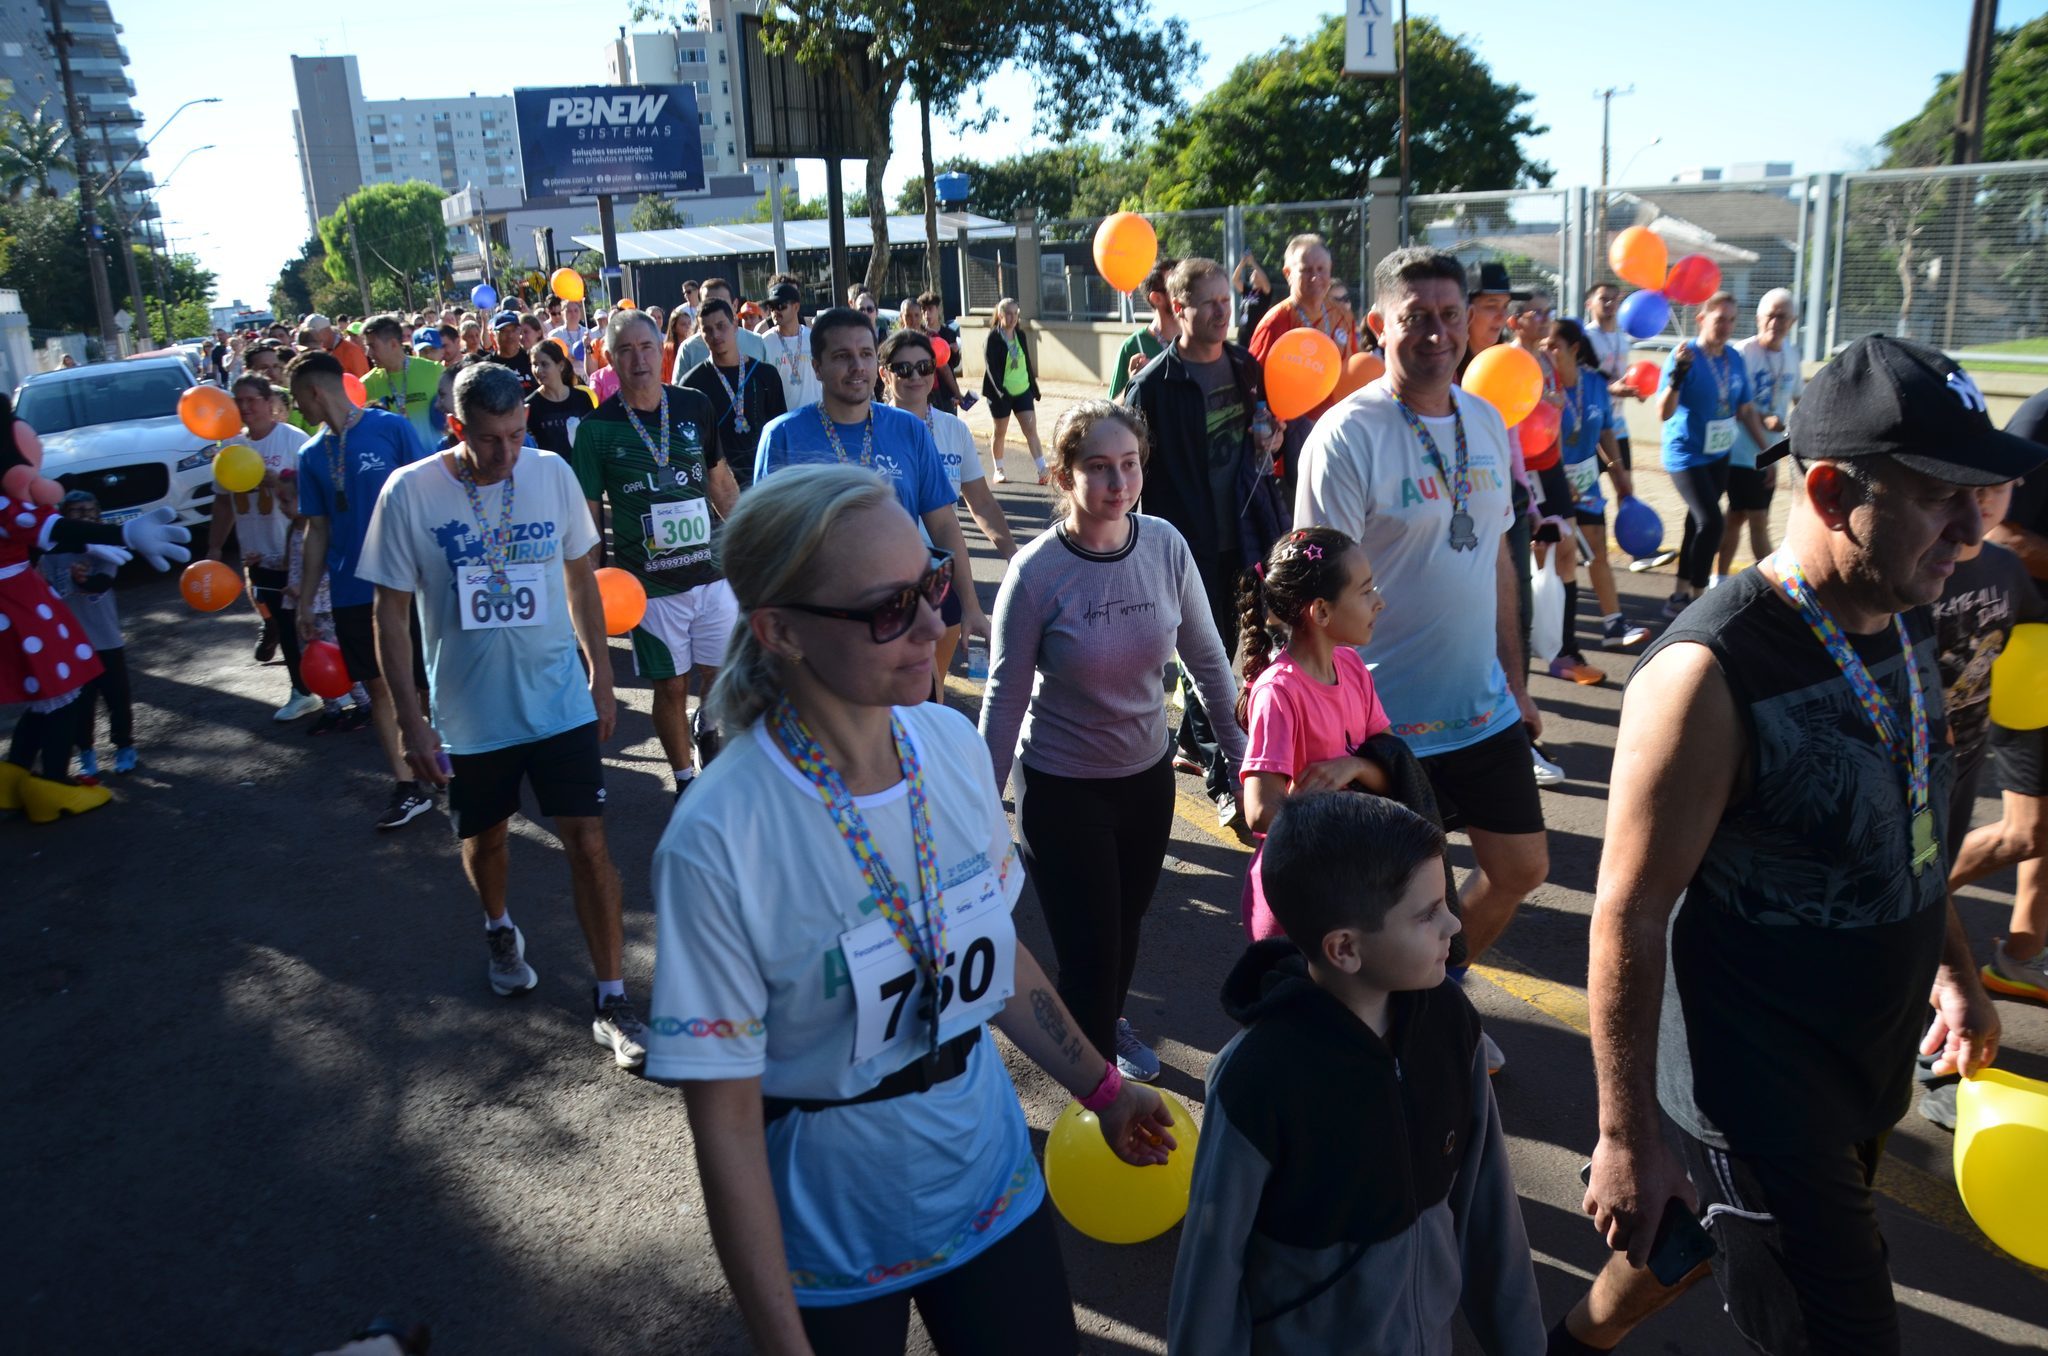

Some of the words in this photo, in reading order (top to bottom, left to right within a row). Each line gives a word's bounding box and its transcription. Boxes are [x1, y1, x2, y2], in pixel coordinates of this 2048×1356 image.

[547, 94, 669, 128] PBNEW
[578, 125, 671, 140] SISTEMAS
[571, 147, 606, 158] Soluções
[607, 145, 653, 156] tecnológicas
[662, 515, 705, 545] 300
